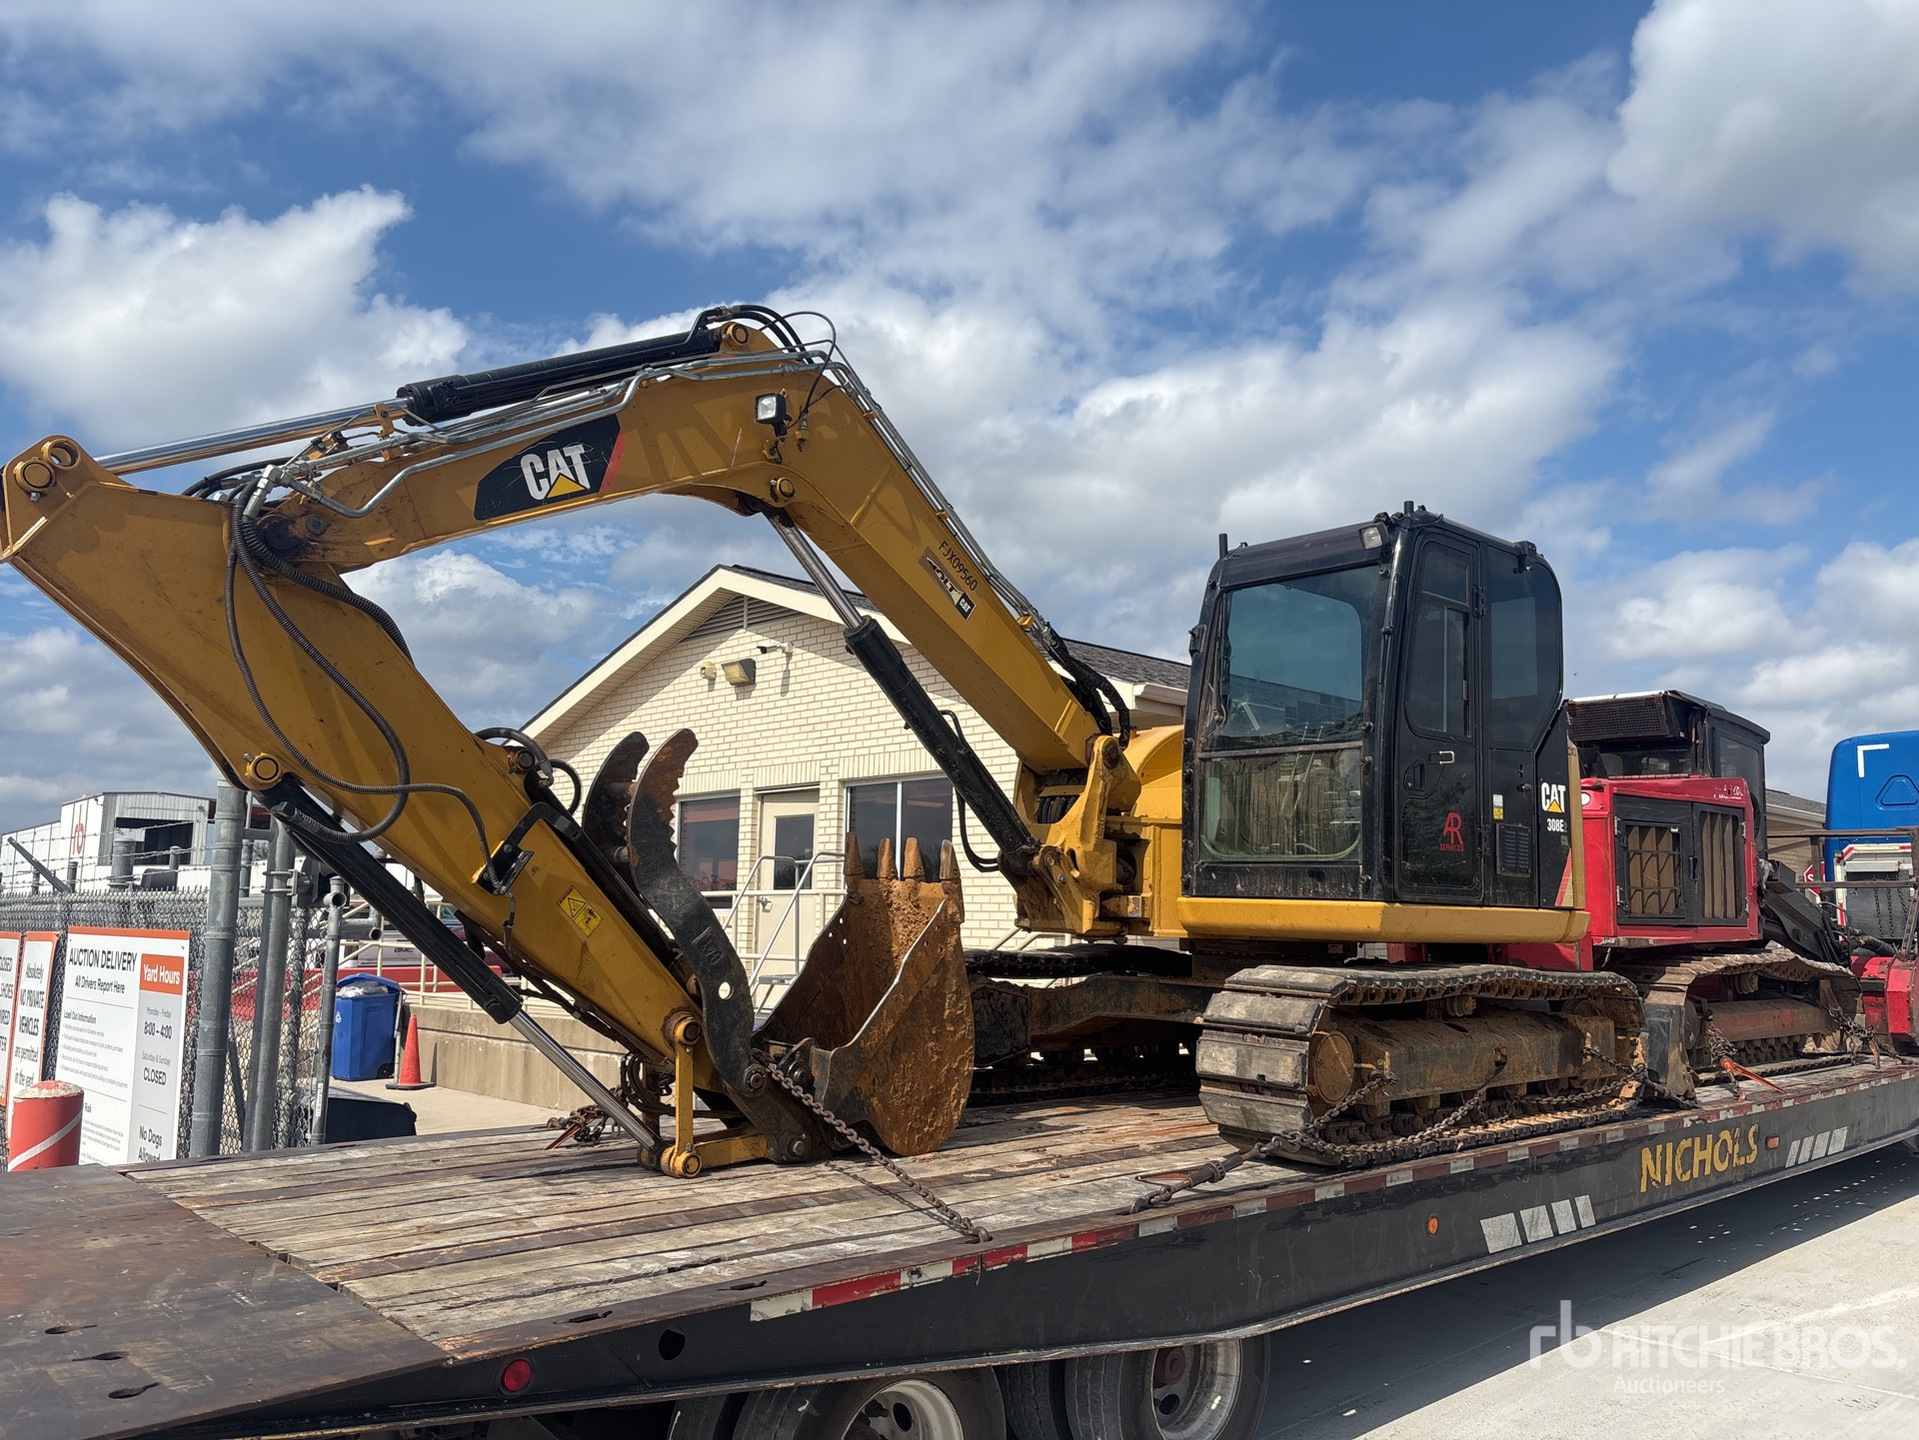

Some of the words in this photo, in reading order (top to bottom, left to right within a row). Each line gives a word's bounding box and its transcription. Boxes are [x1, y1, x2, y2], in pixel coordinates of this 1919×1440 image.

[520, 444, 590, 500] CAT
[938, 541, 978, 591] FJX09560
[959, 598, 972, 613] CAT
[1541, 782, 1566, 813] CAT
[1440, 843, 1464, 852] SERVICES
[69, 948, 100, 968] AUCTION
[100, 950, 138, 972] DELIVERY
[144, 964, 158, 983] Yard
[159, 964, 181, 985] Hours
[81, 976, 97, 989] Drivers
[97, 978, 113, 994] Report
[113, 980, 125, 994] Here
[26, 989, 45, 1009] PRIVATE
[147, 1006, 159, 1018] Monday
[162, 1008, 172, 1019] Friday
[19, 1015, 39, 1037] VEHICLES
[144, 1021, 156, 1036] 8:00
[160, 1024, 173, 1040] 4:00
[20, 1045, 39, 1063] permitted
[142, 1051, 155, 1064] Saturday
[159, 1055, 171, 1067] Sunday
[143, 1067, 167, 1086] CLOSED
[139, 1125, 147, 1141] No
[148, 1128, 163, 1149] Dogs
[1640, 1123, 1759, 1193] NICHOLS
